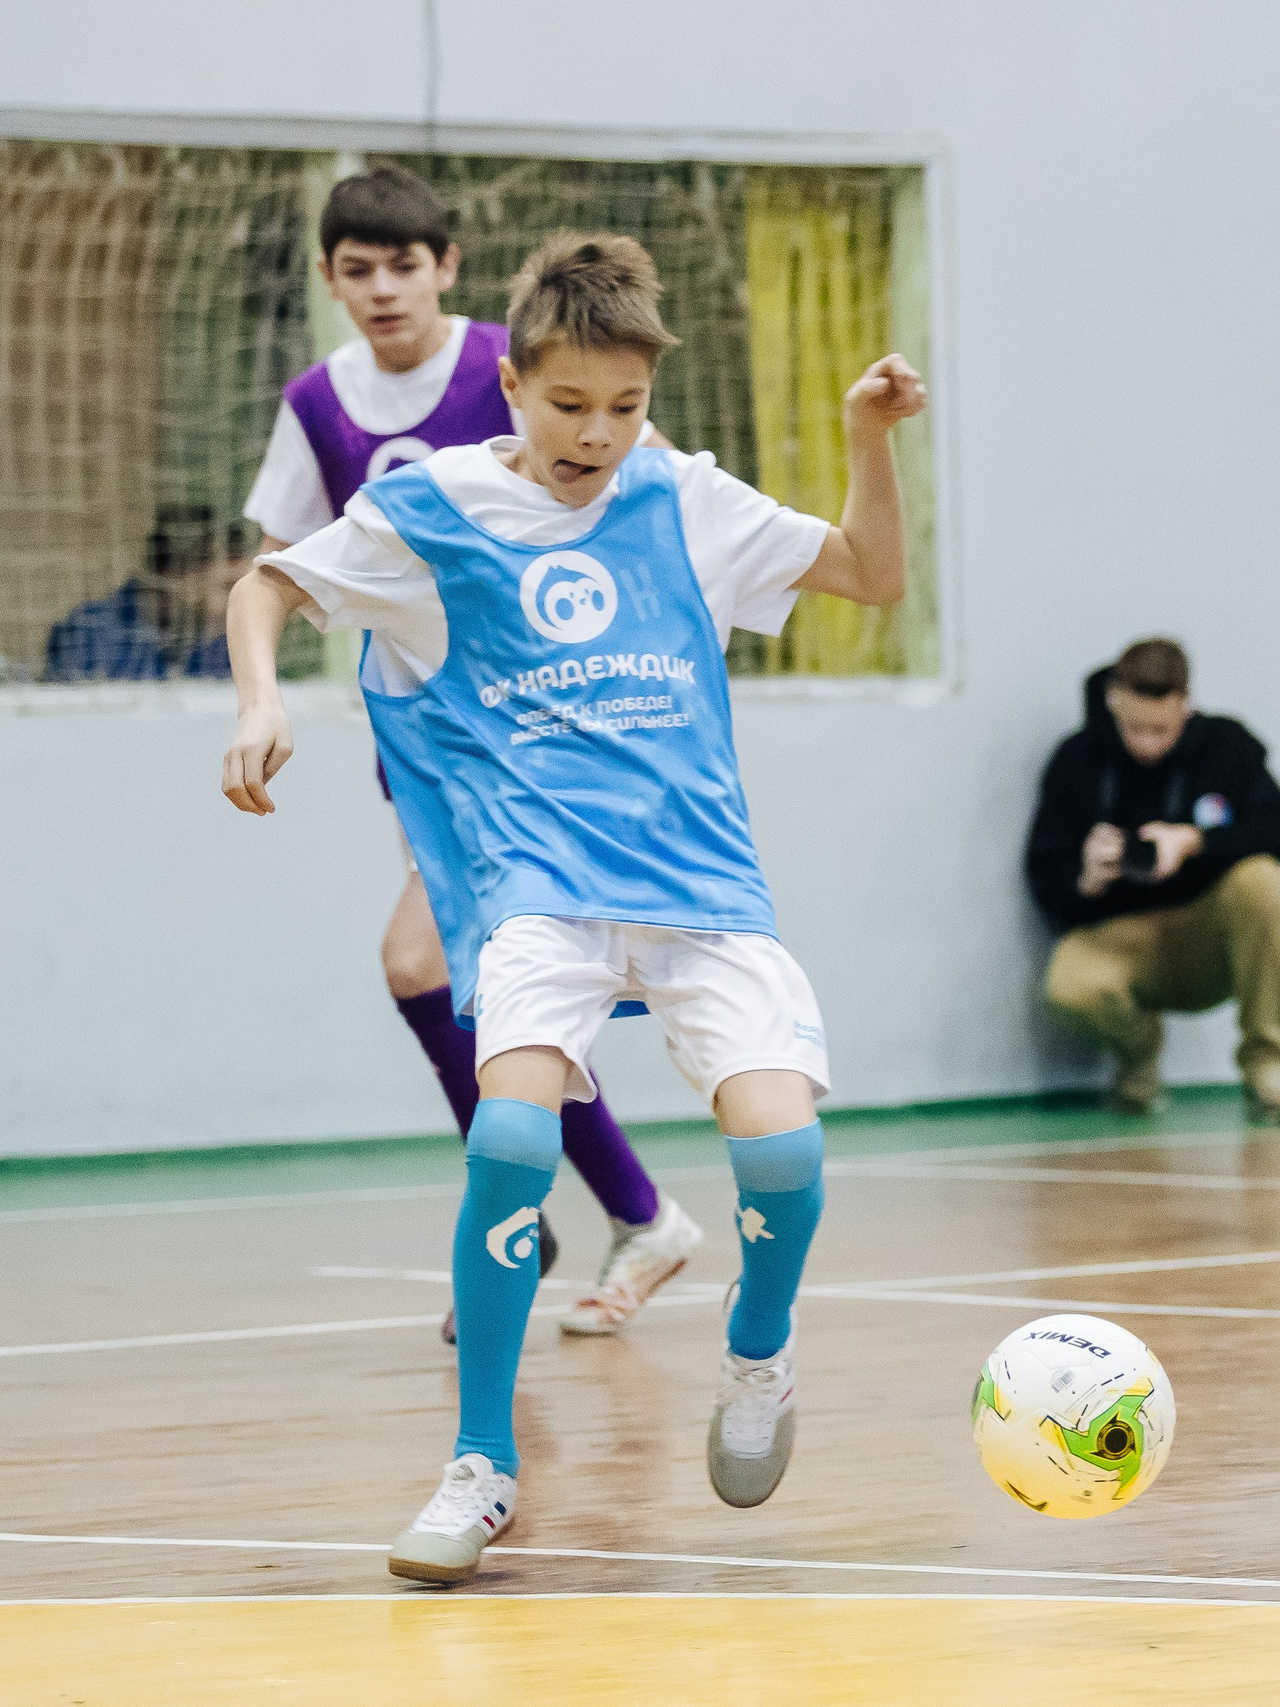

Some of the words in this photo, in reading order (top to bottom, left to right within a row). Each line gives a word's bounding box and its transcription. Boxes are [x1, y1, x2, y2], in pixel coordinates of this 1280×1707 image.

[516, 653, 697, 696] НАДЕЖДИК
[580, 702, 594, 716] К
[596, 695, 673, 715] ПОБЕДЕ!
[606, 713, 690, 732] СИЛЬНЕЕ!
[1022, 1331, 1112, 1359] DEMIX
